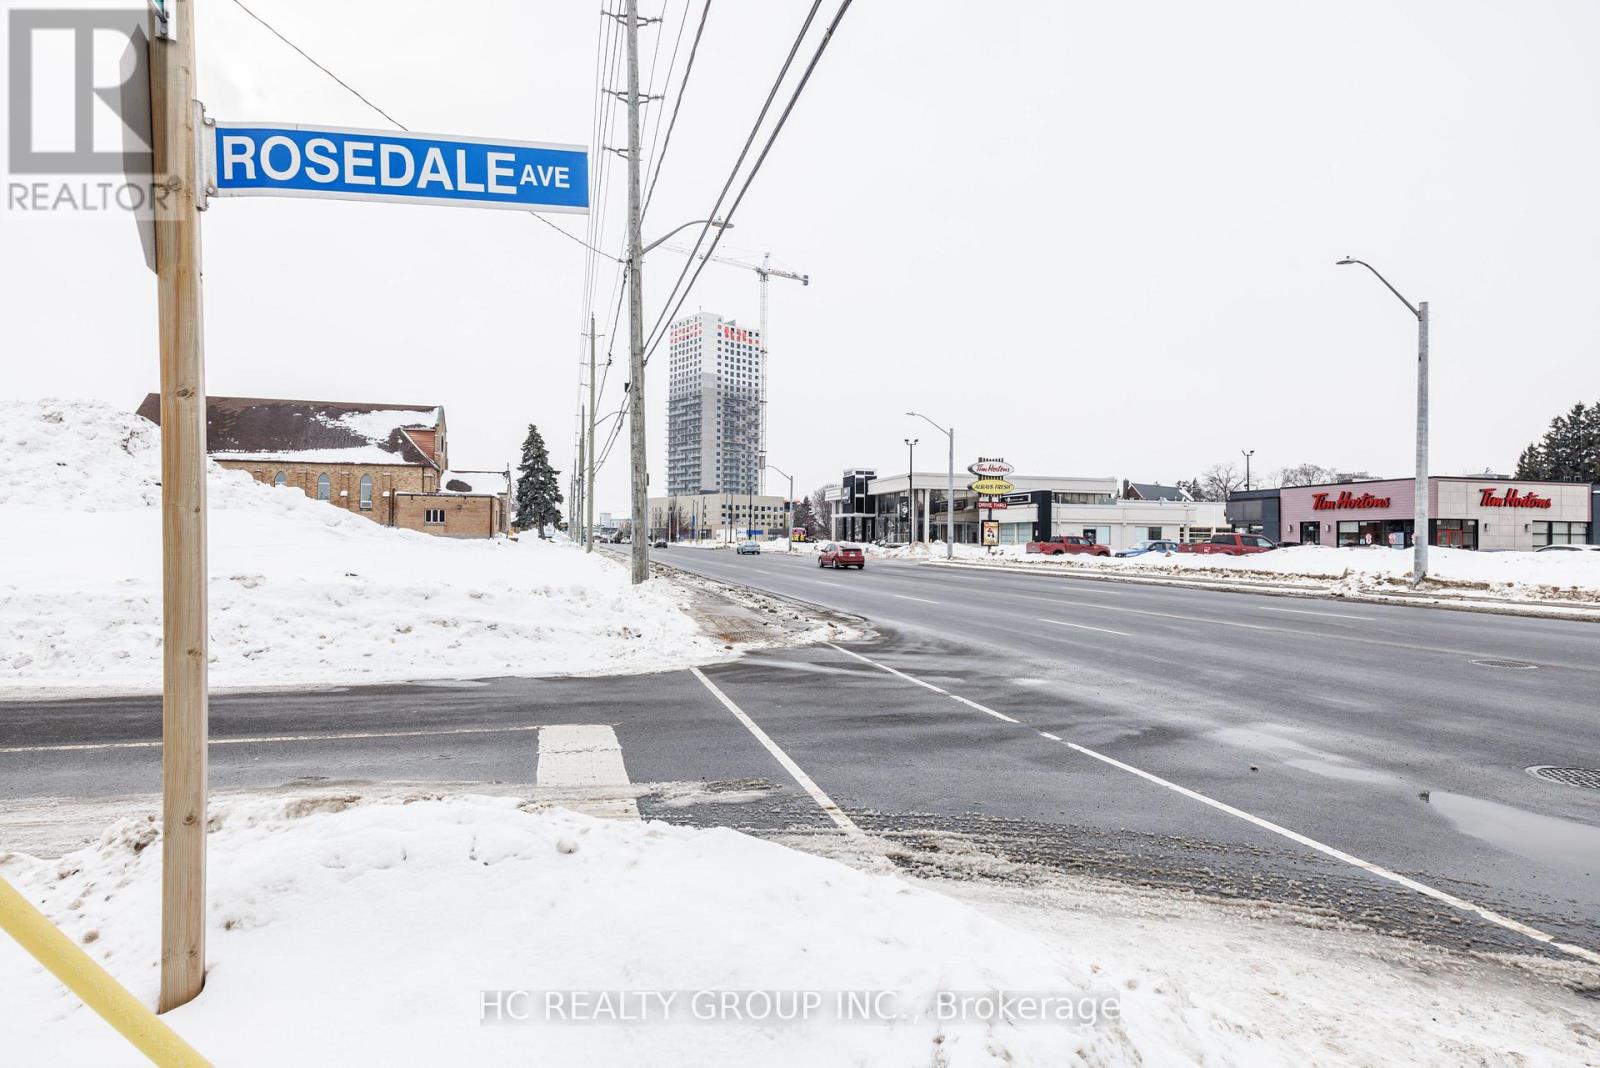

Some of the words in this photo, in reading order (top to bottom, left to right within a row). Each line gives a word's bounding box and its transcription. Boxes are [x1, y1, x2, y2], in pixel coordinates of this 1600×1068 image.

[223, 135, 517, 194] ROSEDALE
[520, 164, 570, 188] AVE
[1312, 493, 1335, 510] Tim
[1336, 491, 1390, 509] Hortons
[1479, 488, 1503, 507] Tim
[1503, 488, 1552, 508] Hortons
